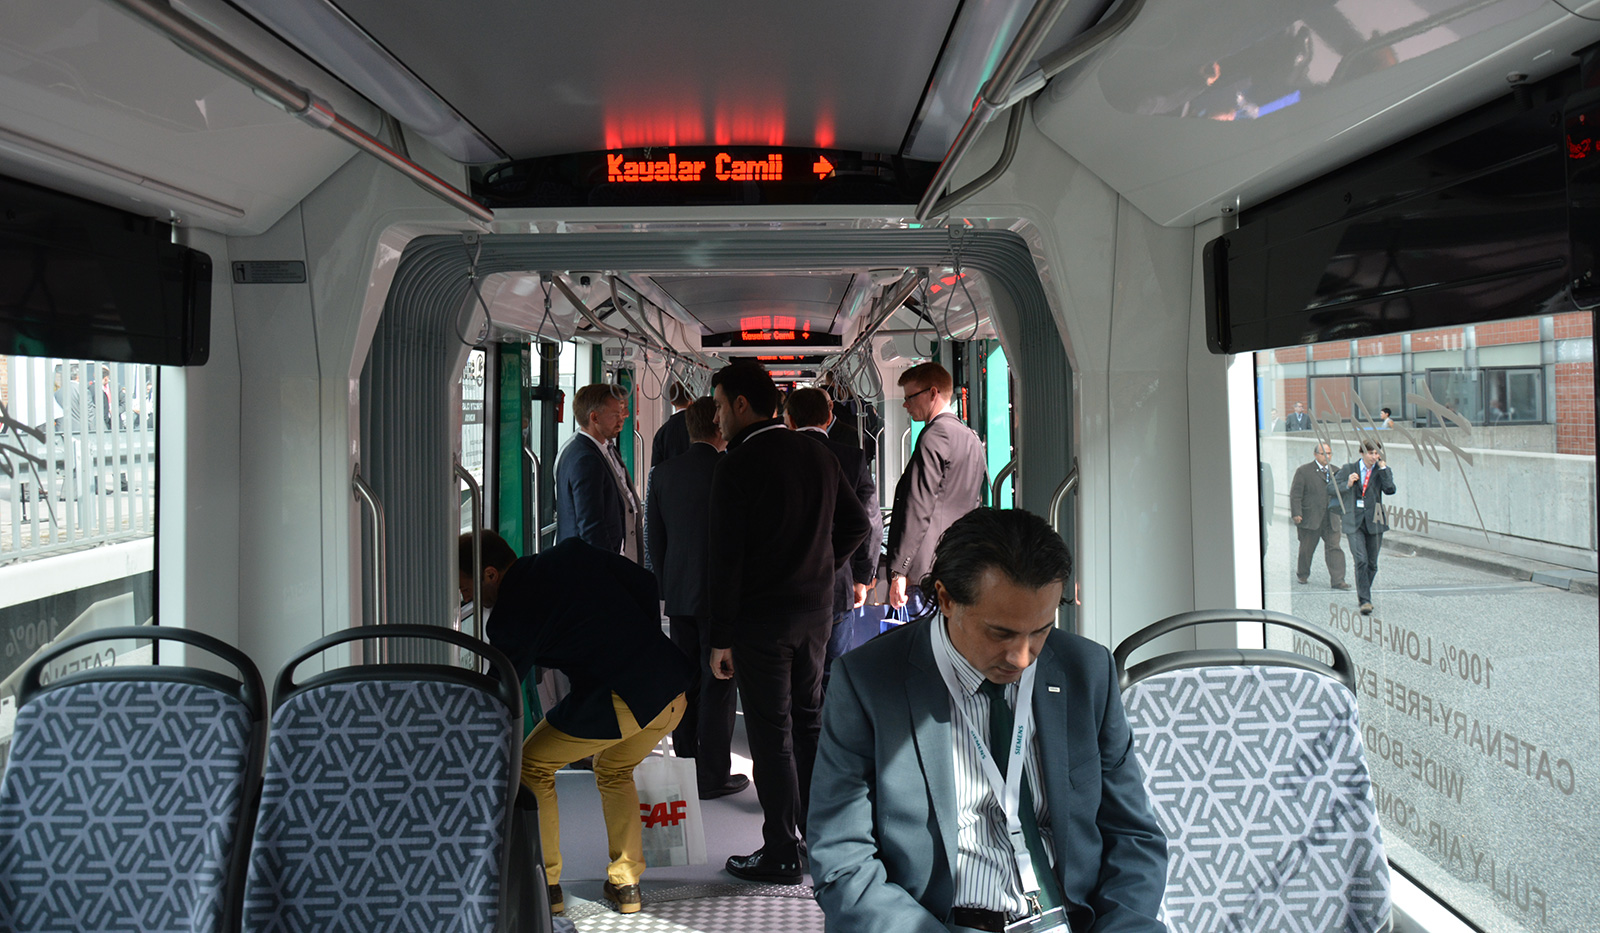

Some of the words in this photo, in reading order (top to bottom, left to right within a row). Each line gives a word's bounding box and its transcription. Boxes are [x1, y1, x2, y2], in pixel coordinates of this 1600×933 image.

[607, 154, 706, 182] Kayalar
[715, 153, 783, 181] Camii
[970, 730, 987, 760] SIEMENS
[1014, 725, 1024, 755] SIEMENS
